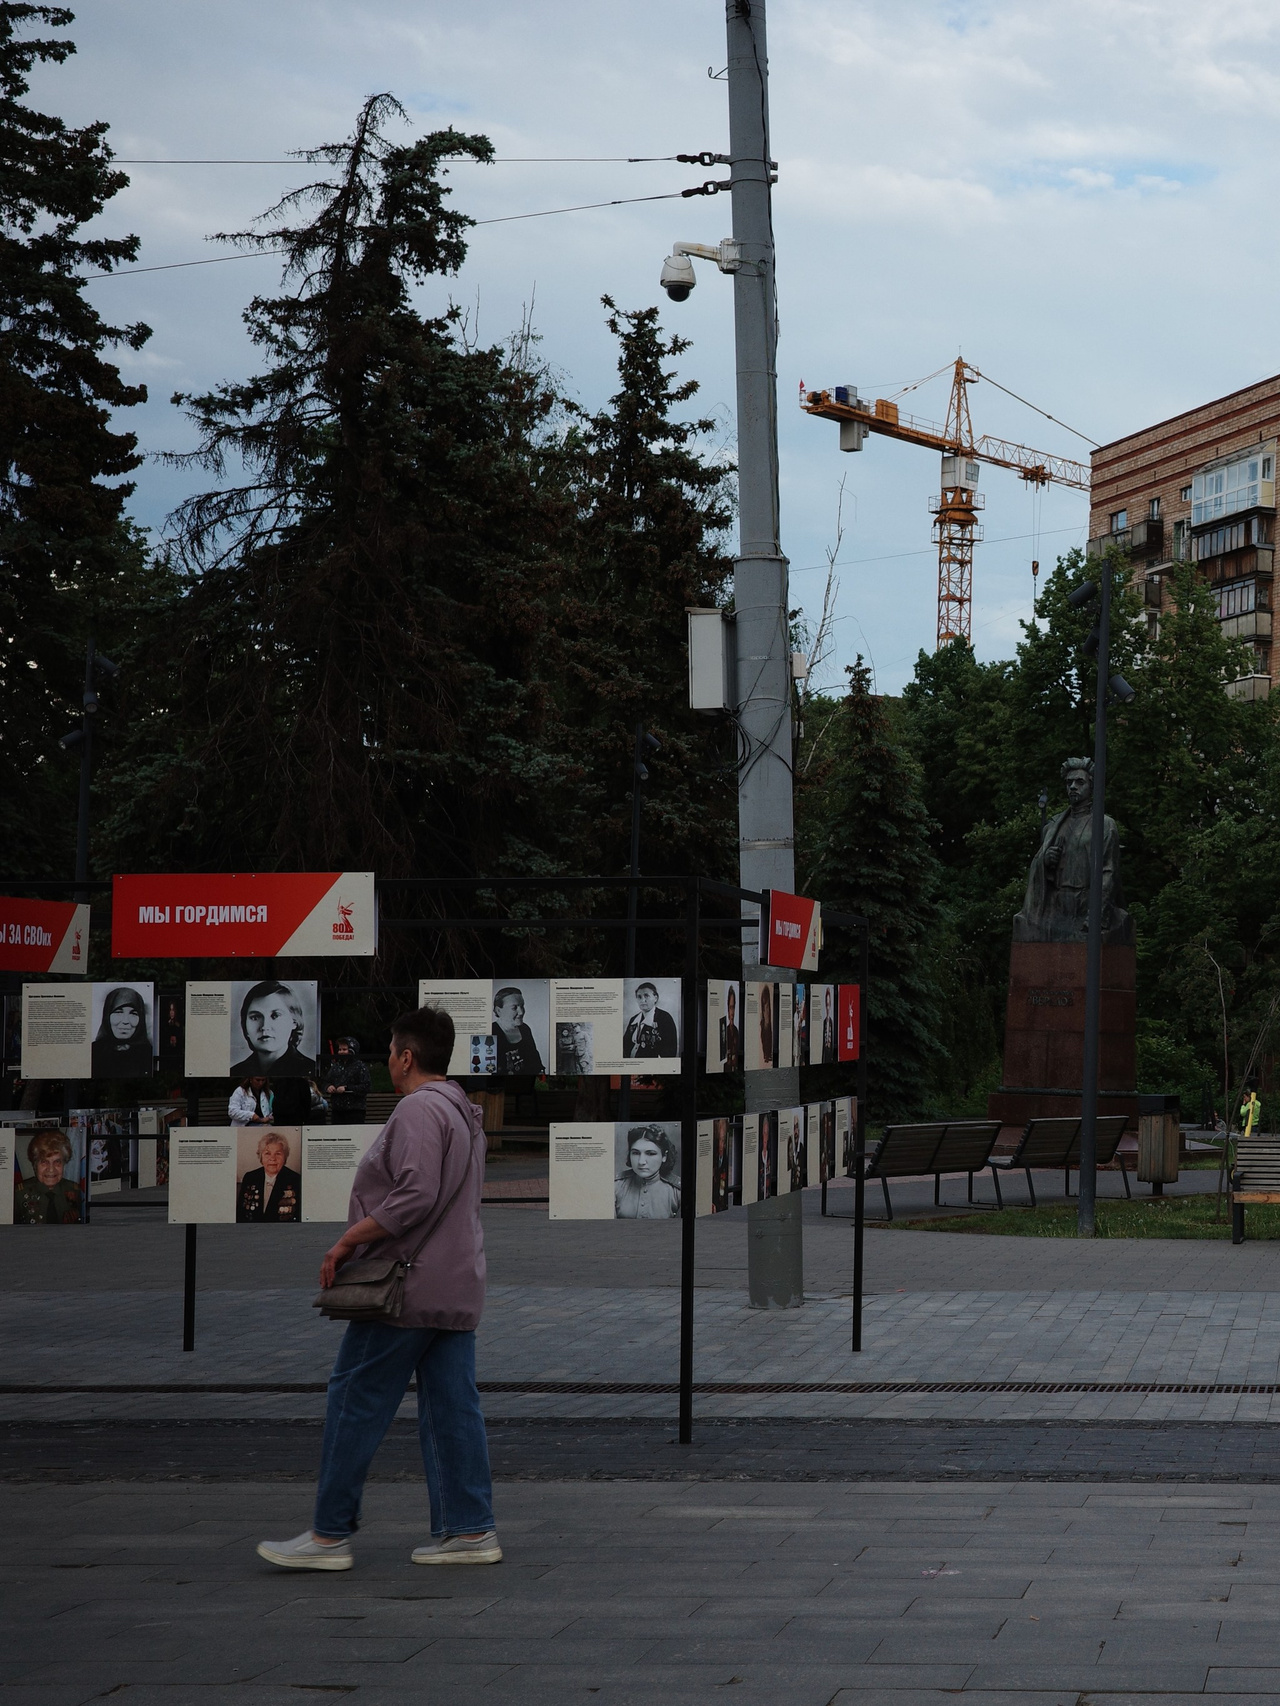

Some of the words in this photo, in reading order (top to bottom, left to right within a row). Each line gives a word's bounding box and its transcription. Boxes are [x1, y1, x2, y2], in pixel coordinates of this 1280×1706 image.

[138, 905, 170, 924] МЫ
[175, 904, 268, 926] ГОРДИМСЯ
[8, 923, 22, 945] ЗА
[332, 922, 345, 934] 80
